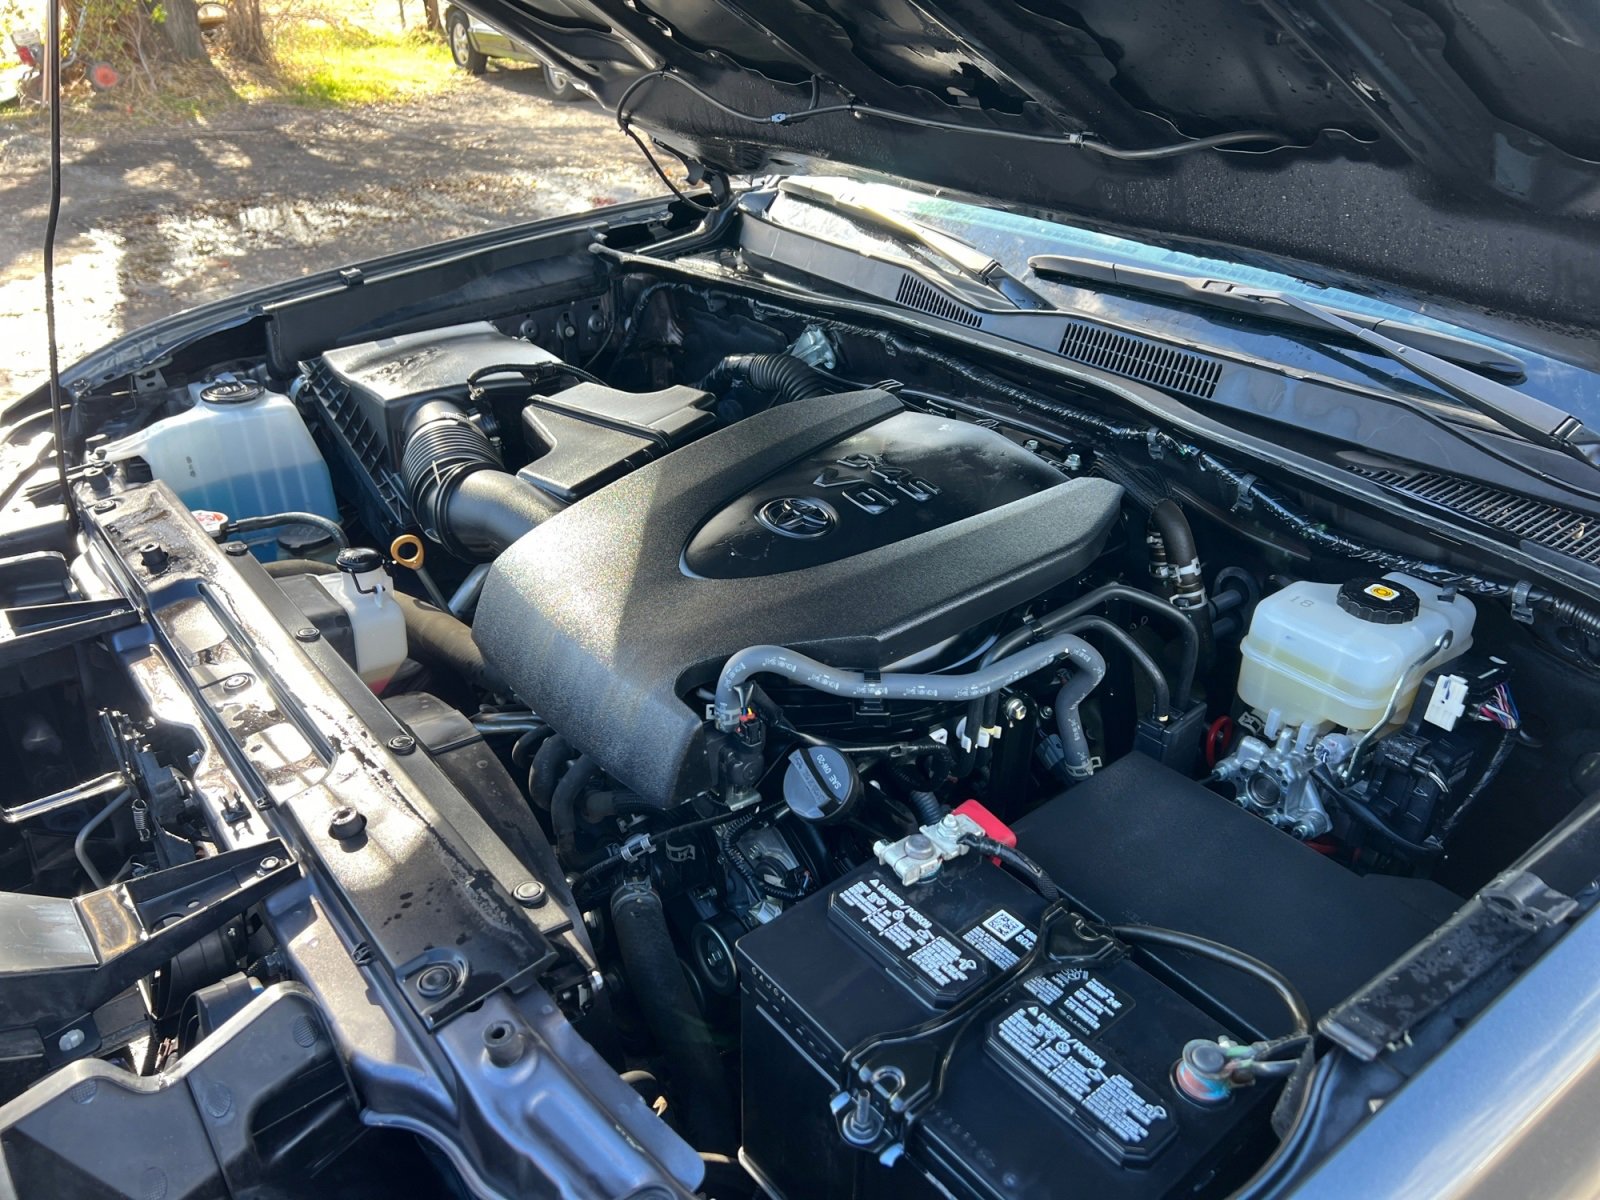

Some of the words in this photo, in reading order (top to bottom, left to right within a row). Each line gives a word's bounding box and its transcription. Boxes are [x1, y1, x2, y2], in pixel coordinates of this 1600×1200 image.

[813, 467, 899, 515] V6
[816, 754, 832, 775] 0W-20
[829, 774, 842, 790] SAE
